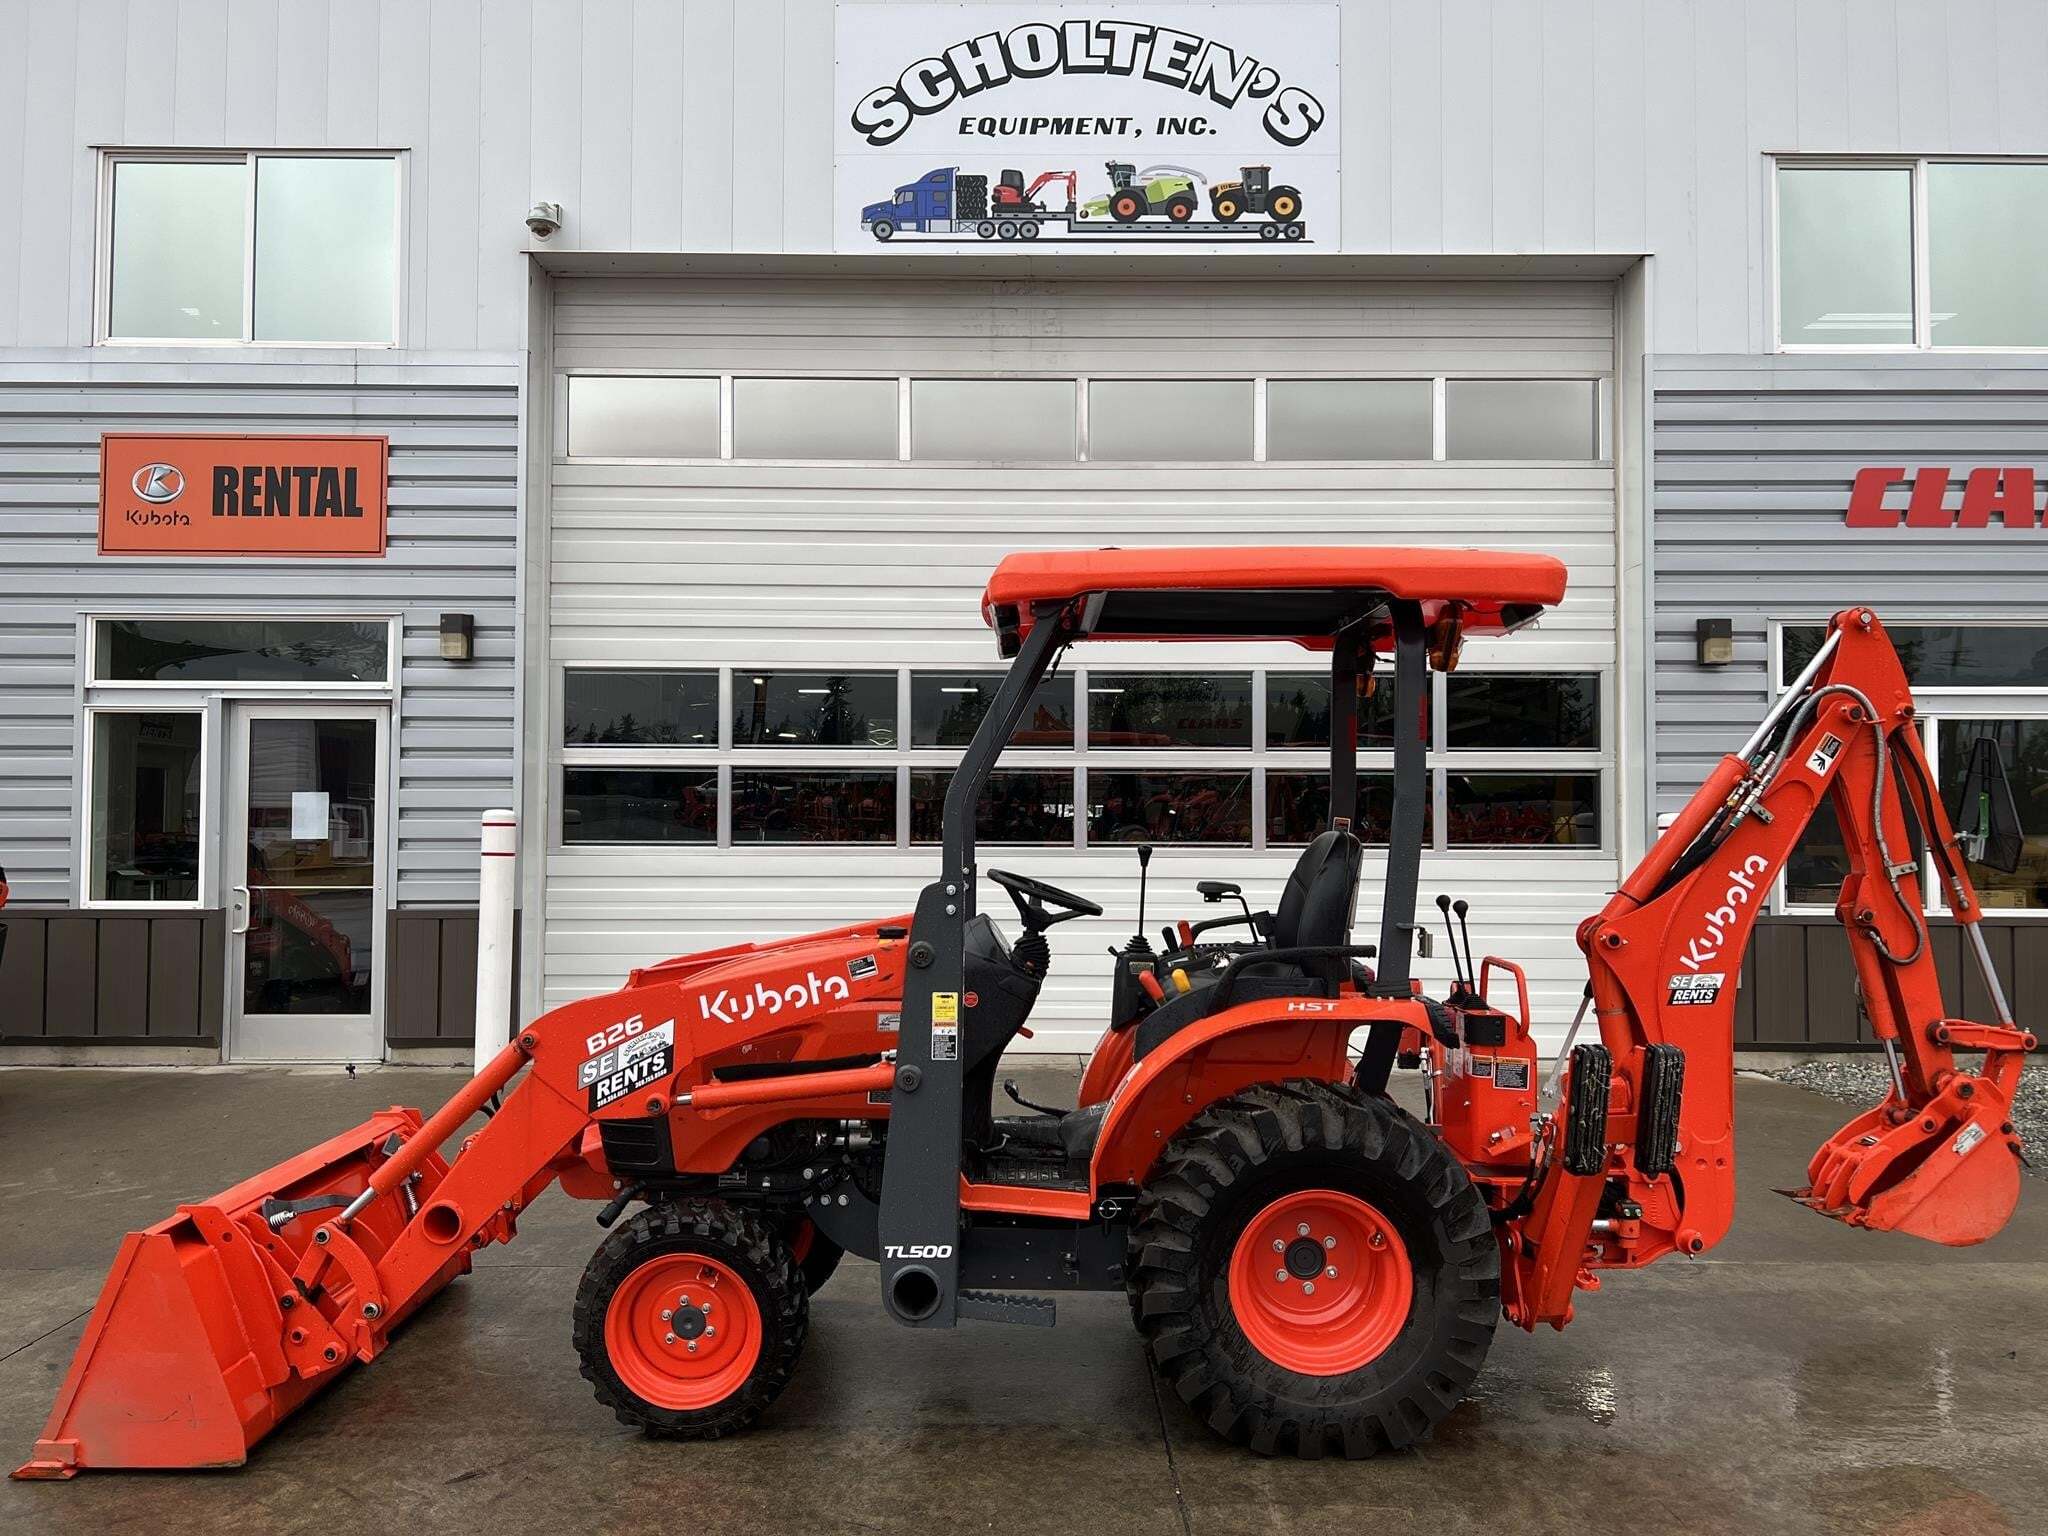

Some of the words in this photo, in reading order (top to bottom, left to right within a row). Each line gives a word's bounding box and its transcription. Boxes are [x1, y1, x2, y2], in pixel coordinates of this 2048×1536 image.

[851, 19, 1325, 147] SCHOLTEN'S
[958, 117, 1143, 138] EQUIPMENT,
[1156, 117, 1218, 136] INC.
[212, 465, 363, 518] RENTAL
[1845, 467, 2048, 529] CLA
[126, 509, 190, 526] Kubota
[1679, 854, 1769, 971] Kubota
[699, 971, 849, 1024] Kubota
[1671, 976, 1691, 988] SE
[1673, 988, 1715, 1001] RENTS
[1287, 1002, 1340, 1013] HST
[585, 1013, 644, 1056] B26
[582, 1052, 615, 1084] SE
[596, 1051, 666, 1101] RENTS
[884, 1245, 953, 1259] TL500
